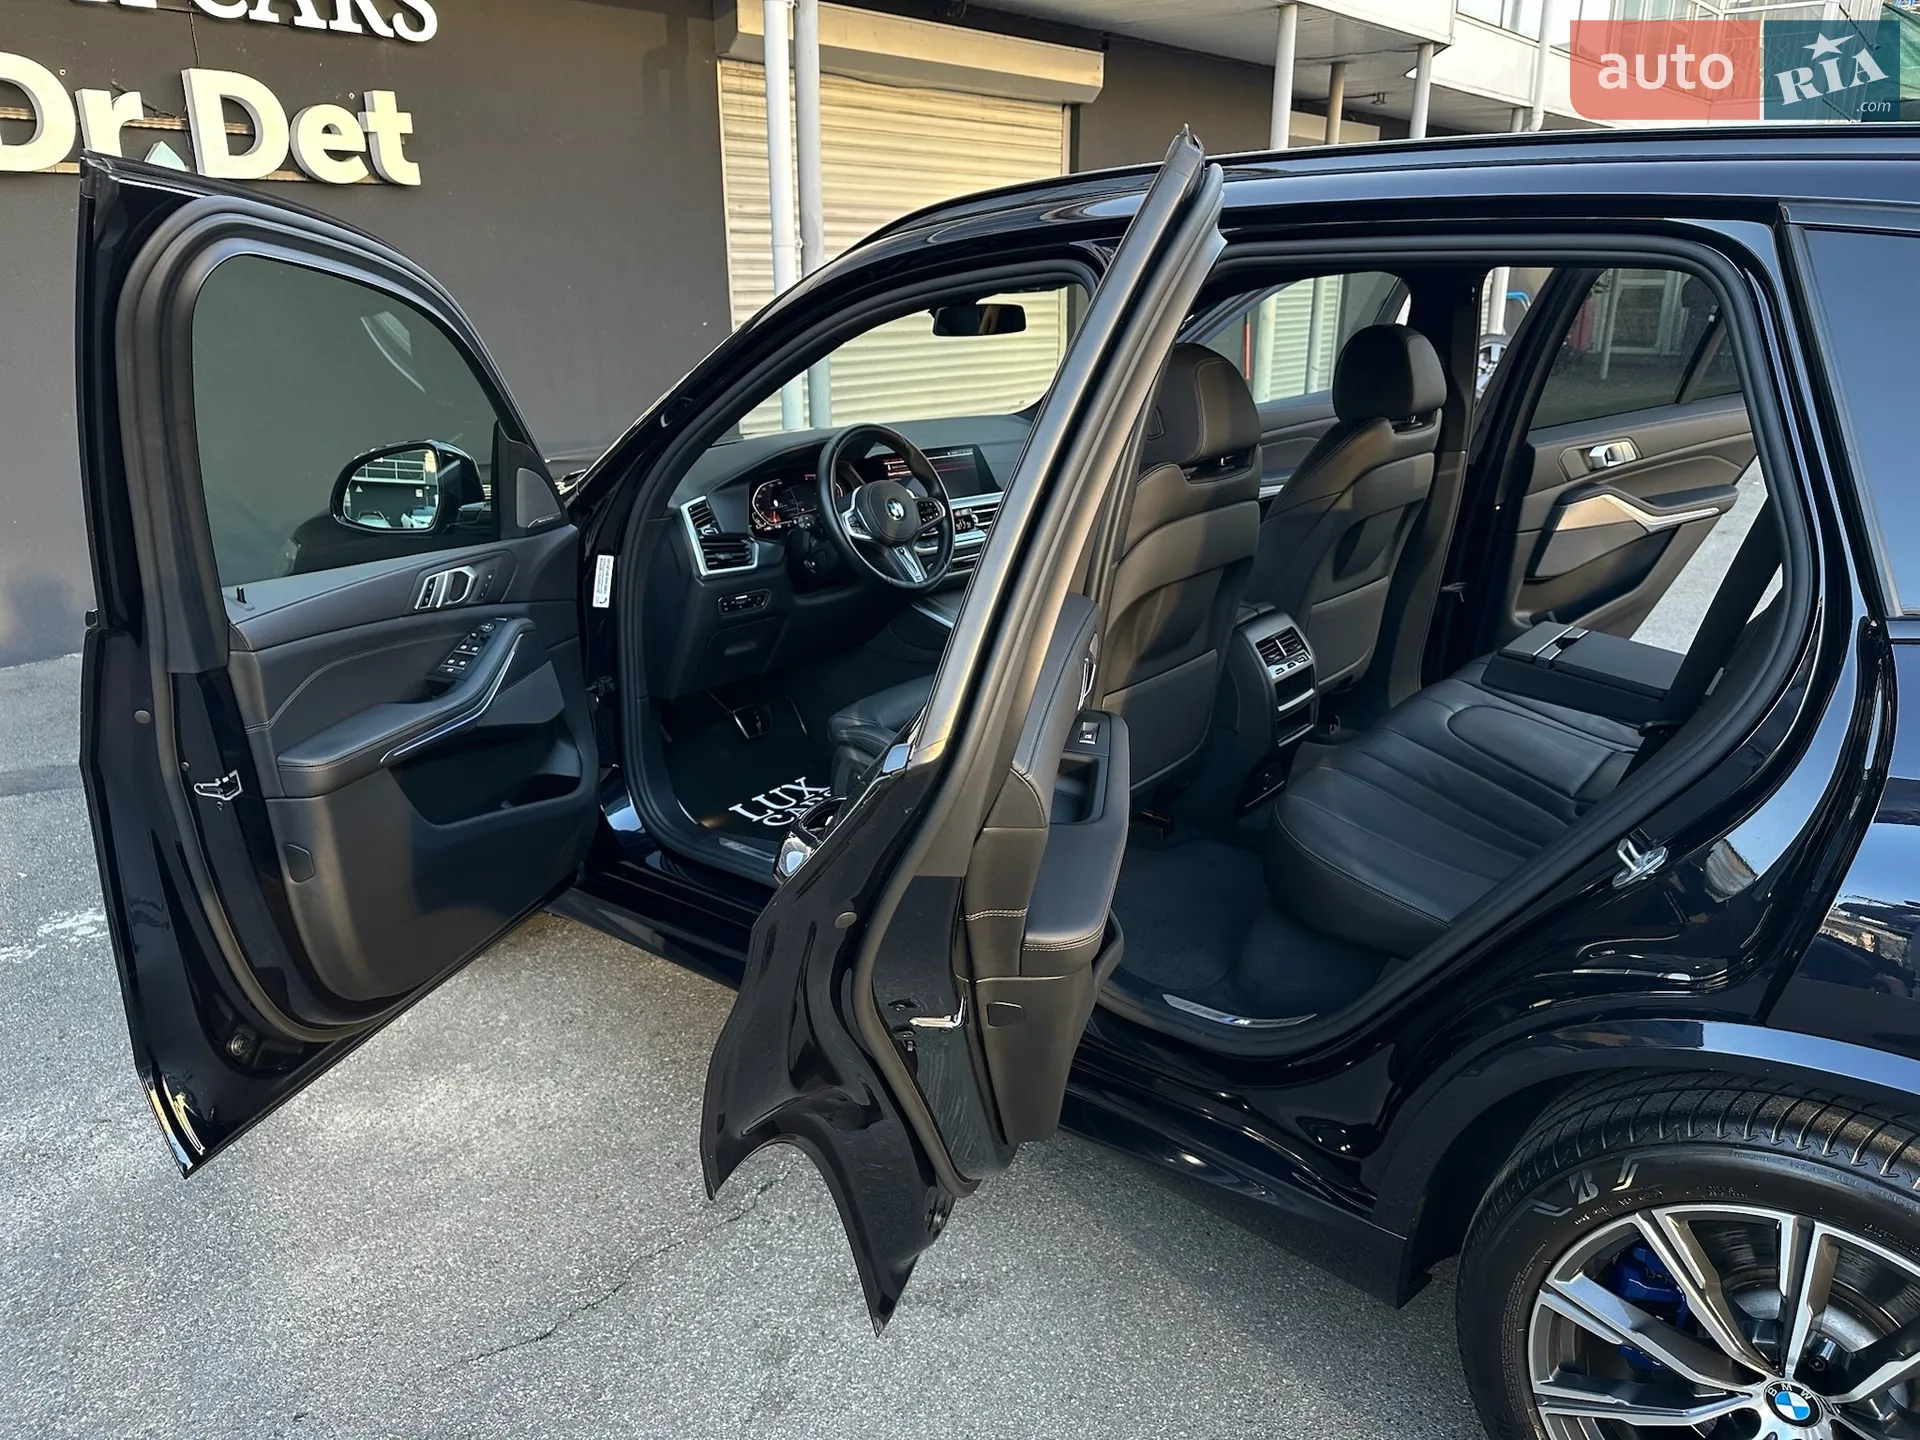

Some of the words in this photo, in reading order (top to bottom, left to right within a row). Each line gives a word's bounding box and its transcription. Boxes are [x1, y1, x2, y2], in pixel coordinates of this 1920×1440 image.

[181, 68, 421, 186] Det
[728, 776, 831, 822] LUX
[762, 790, 832, 826] CA
[1767, 1383, 1813, 1401] BMW
